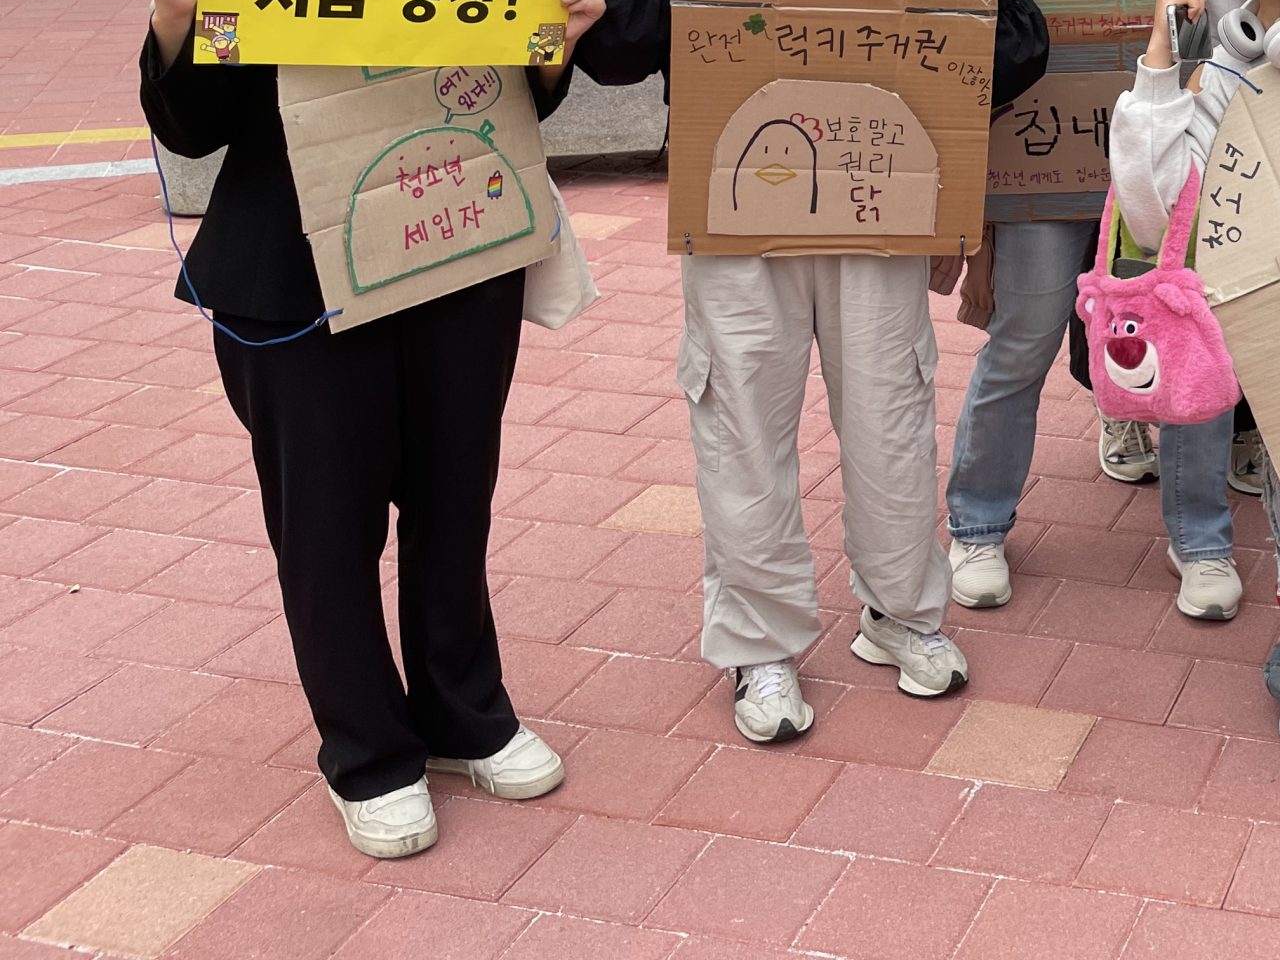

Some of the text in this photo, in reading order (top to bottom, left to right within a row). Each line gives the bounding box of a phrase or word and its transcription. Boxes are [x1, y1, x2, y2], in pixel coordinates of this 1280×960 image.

[687, 28, 747, 64] 완전
[774, 24, 845, 66] 럭키
[396, 154, 467, 200] 청소년
[838, 151, 894, 182] 권리
[850, 184, 883, 224] 닭
[1201, 141, 1263, 251] 청소년
[404, 200, 486, 250] 세입자
